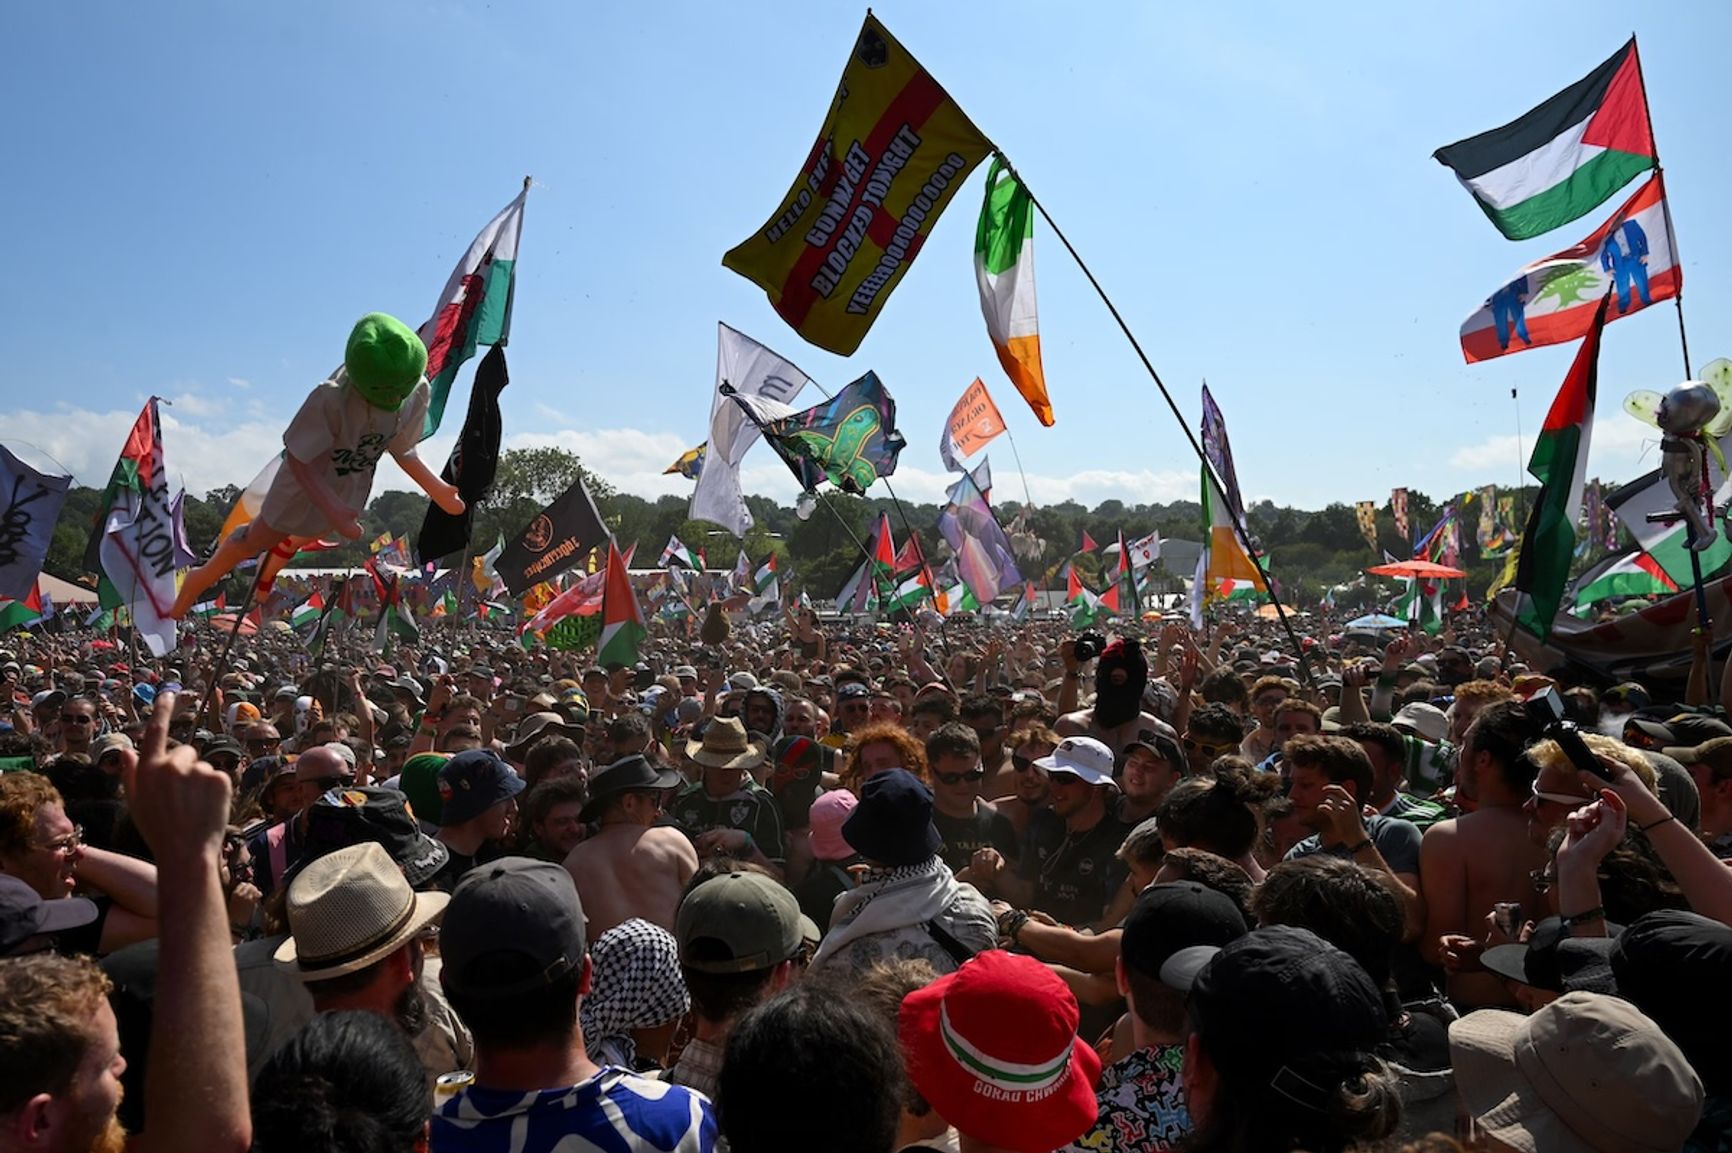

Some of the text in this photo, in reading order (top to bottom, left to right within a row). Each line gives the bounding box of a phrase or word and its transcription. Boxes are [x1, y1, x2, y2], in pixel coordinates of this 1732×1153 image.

[843, 139, 871, 185] GET
[766, 190, 811, 244] HELLO
[811, 123, 921, 298] BLOCKED TONIGHT
